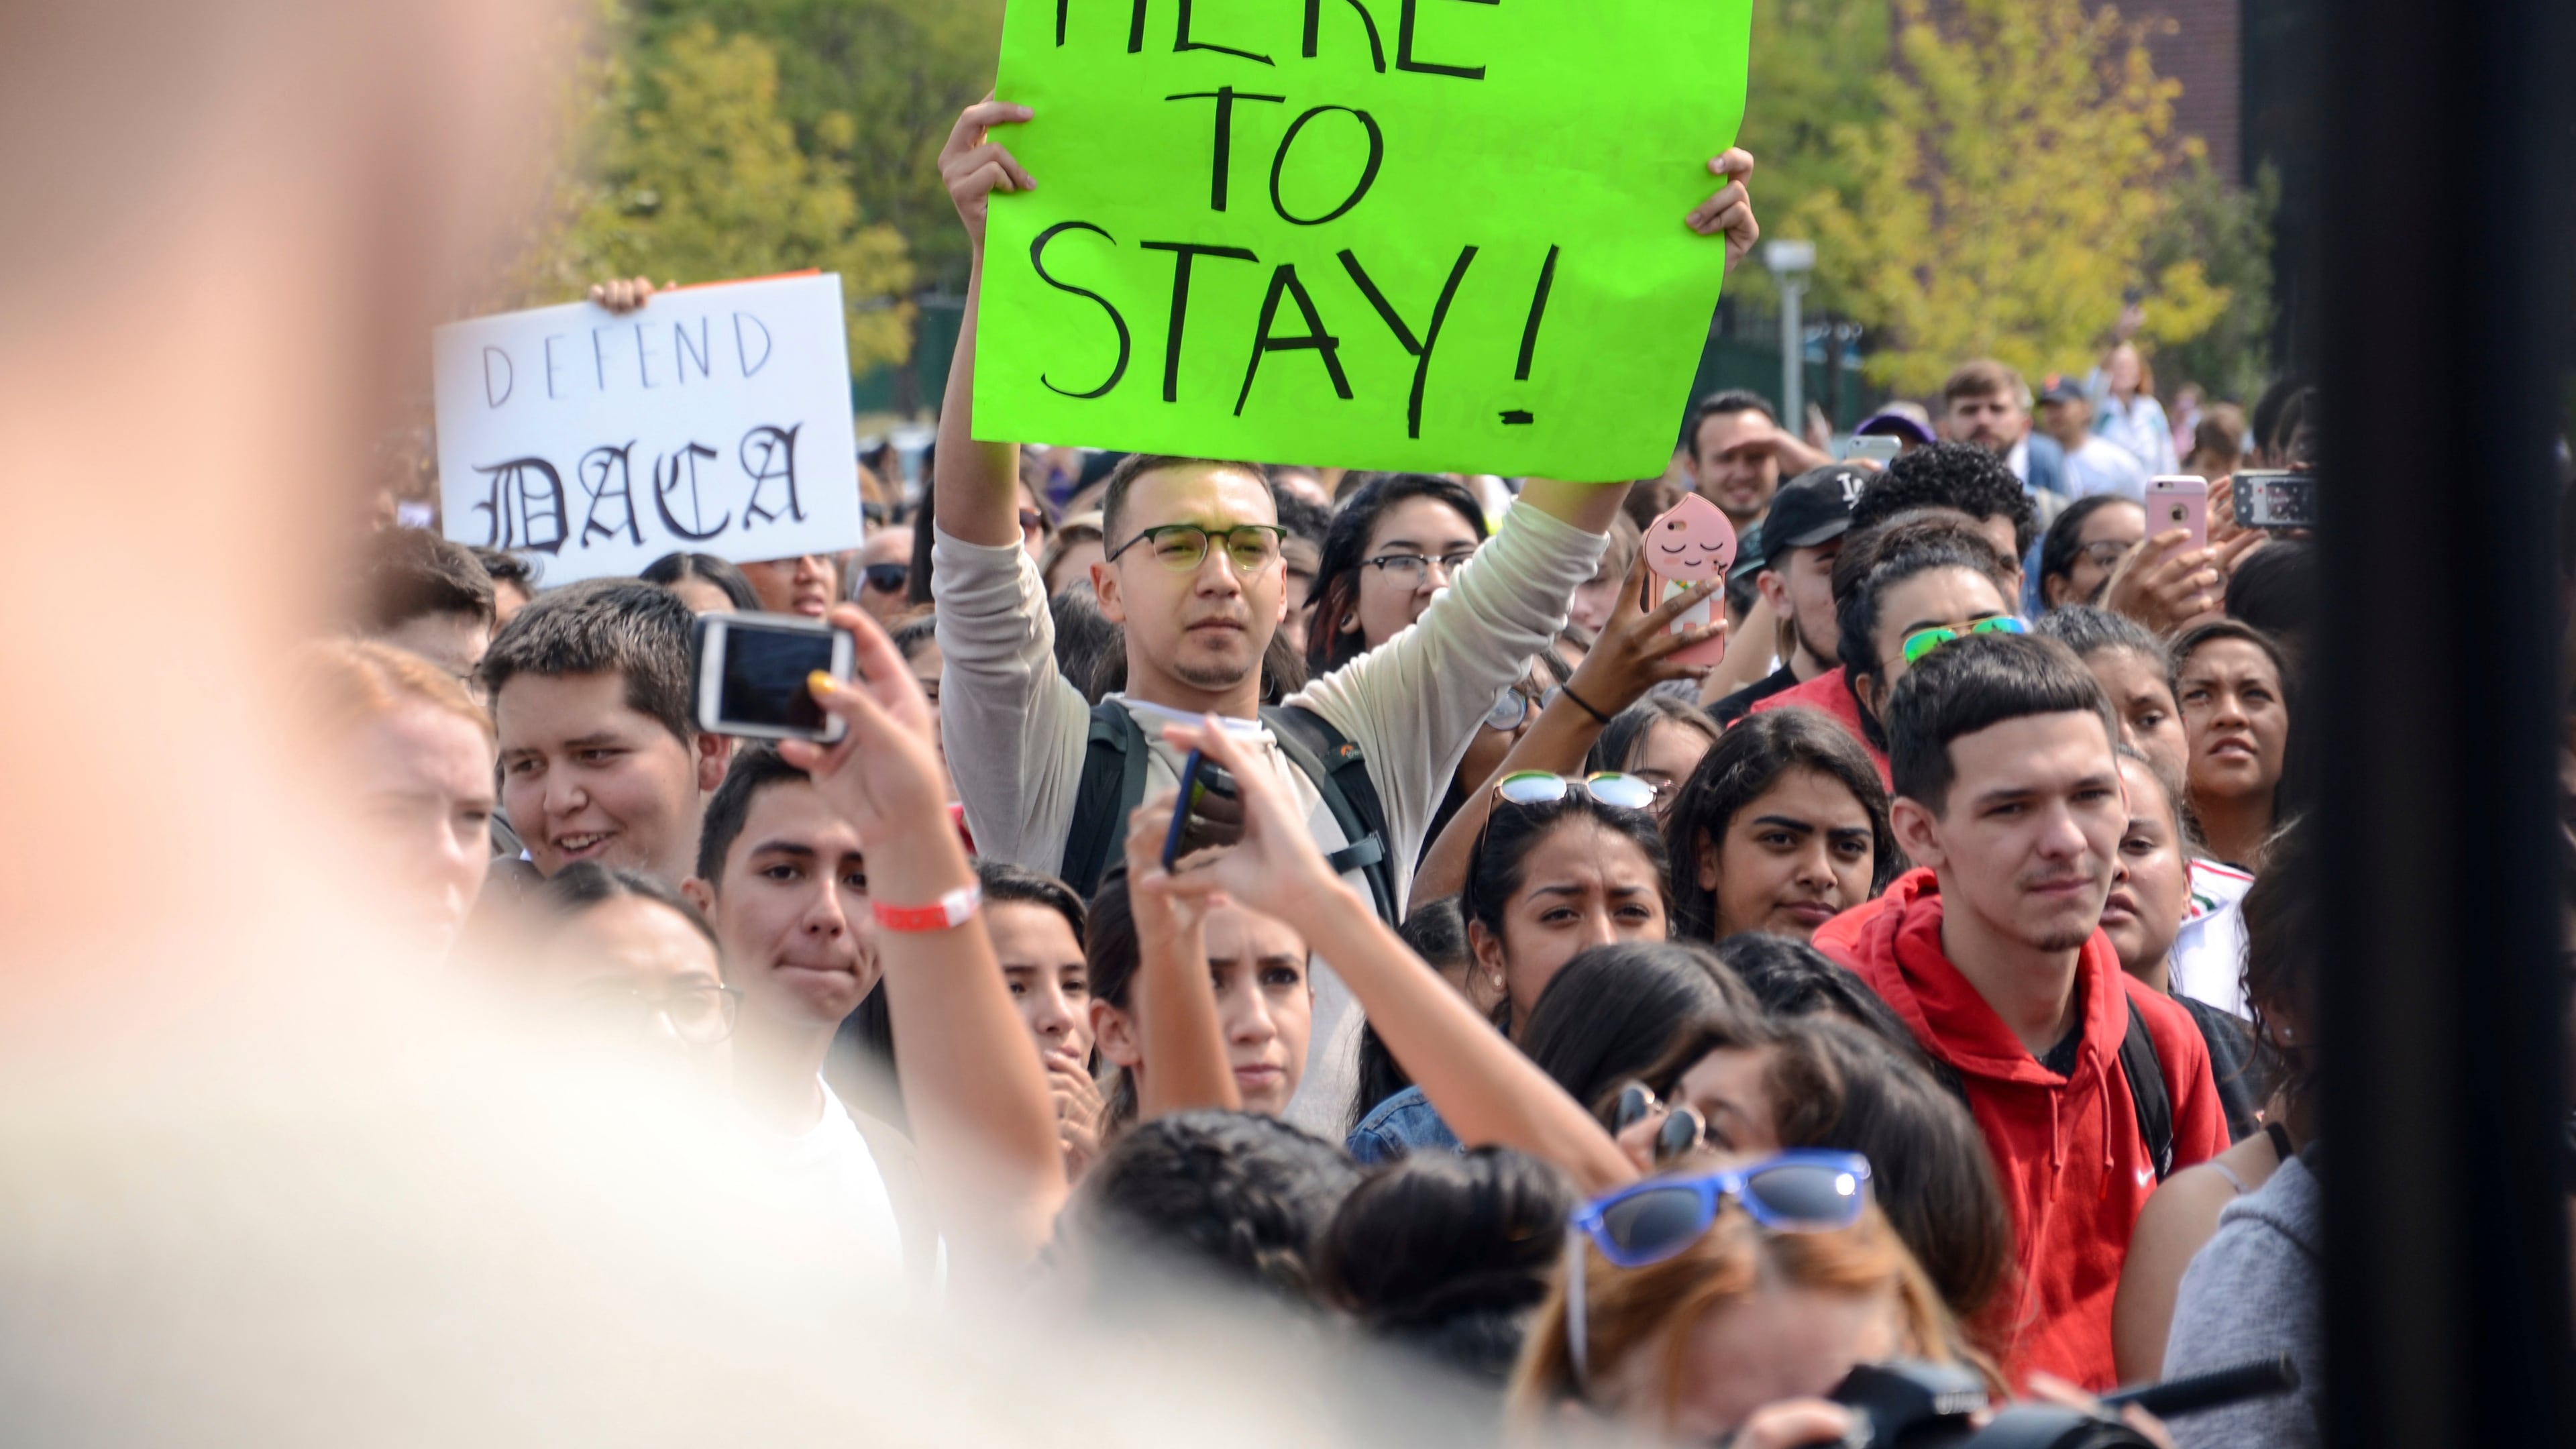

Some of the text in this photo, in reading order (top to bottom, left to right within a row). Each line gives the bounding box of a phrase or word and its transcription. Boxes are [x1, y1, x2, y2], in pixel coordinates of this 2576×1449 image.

[1165, 86, 1383, 225] TO
[482, 311, 771, 409] DEFEND
[1030, 221, 1559, 439] STAY!
[471, 421, 808, 557] DACA
